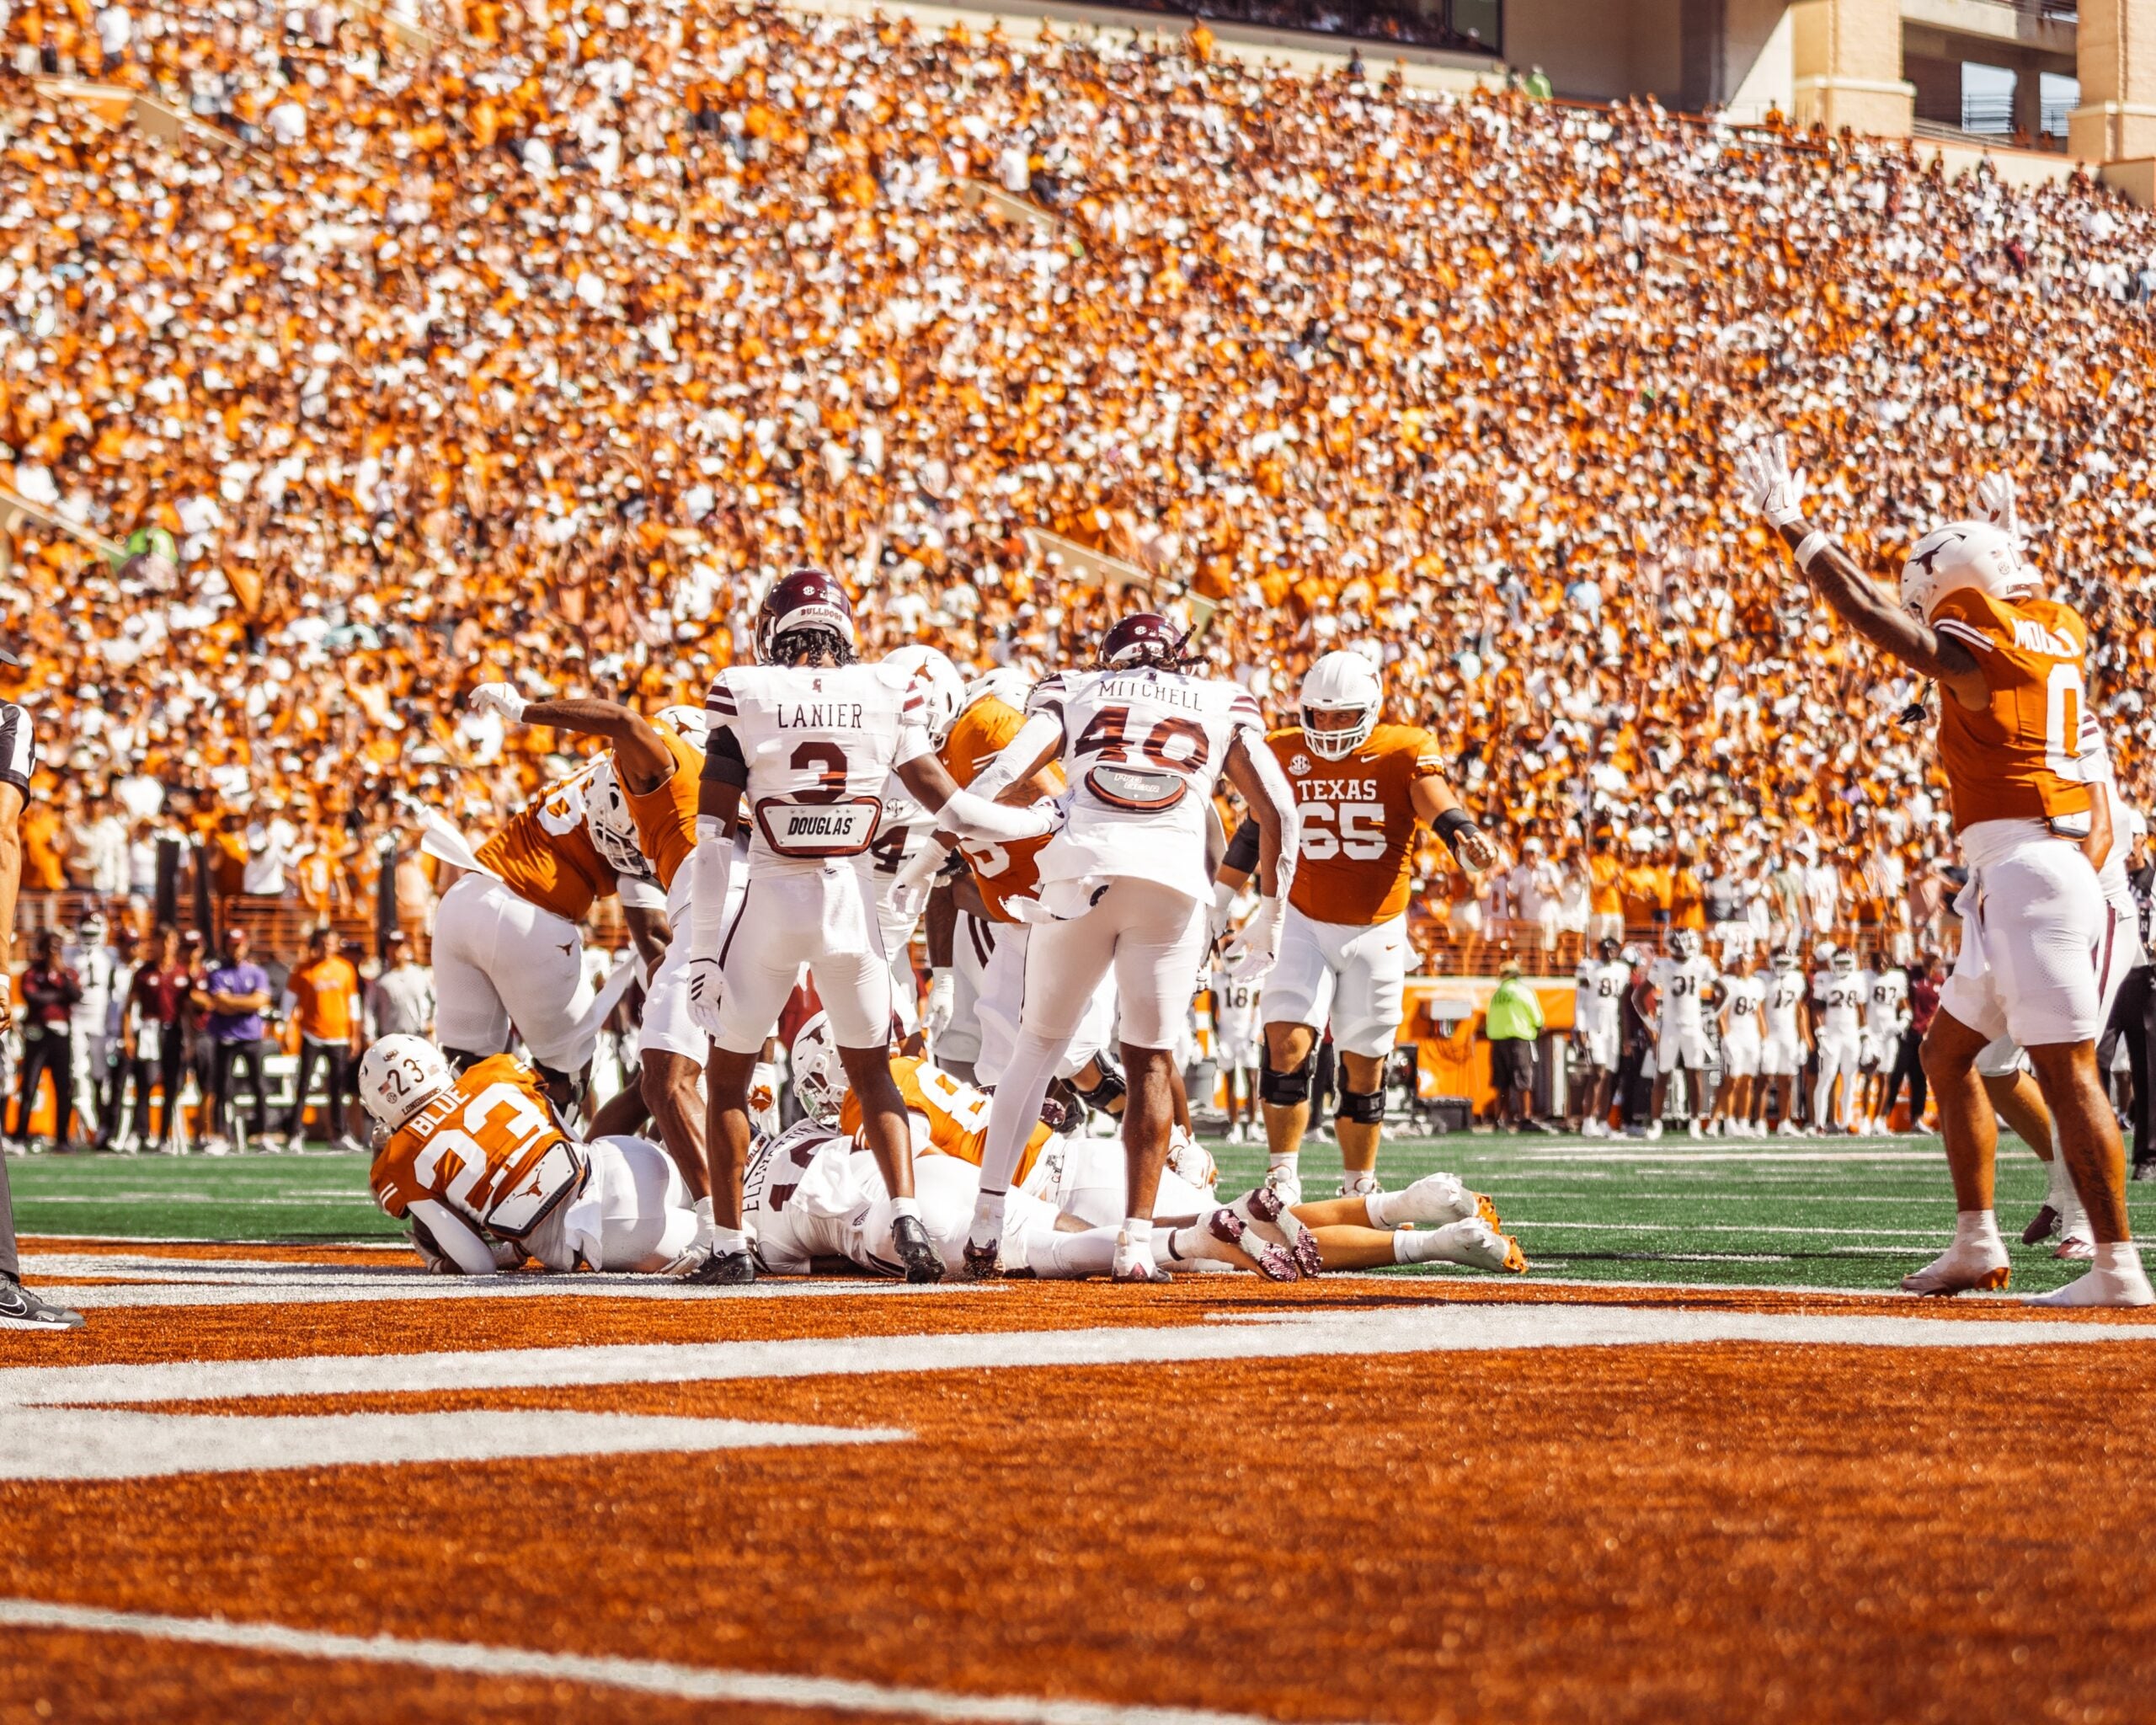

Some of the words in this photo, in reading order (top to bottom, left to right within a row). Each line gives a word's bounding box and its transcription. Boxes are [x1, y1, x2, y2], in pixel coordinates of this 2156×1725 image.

[801, 608, 843, 622] BULLDOGS
[1098, 681, 1203, 712] MITCHELL
[777, 703, 862, 728] LANIER
[1075, 706, 1209, 774] 40
[790, 741, 848, 804] 3
[1296, 779, 1377, 801] TEXAS
[787, 816, 853, 836] DOUGLAS
[1296, 802, 1388, 860] 65
[1225, 986, 1249, 1008] 18
[1671, 975, 1696, 997] 31
[387, 1058, 424, 1097] 23
[402, 1087, 441, 1116] LONGHORNS
[408, 1086, 472, 1138] BLUE
[414, 1082, 558, 1211] 23
